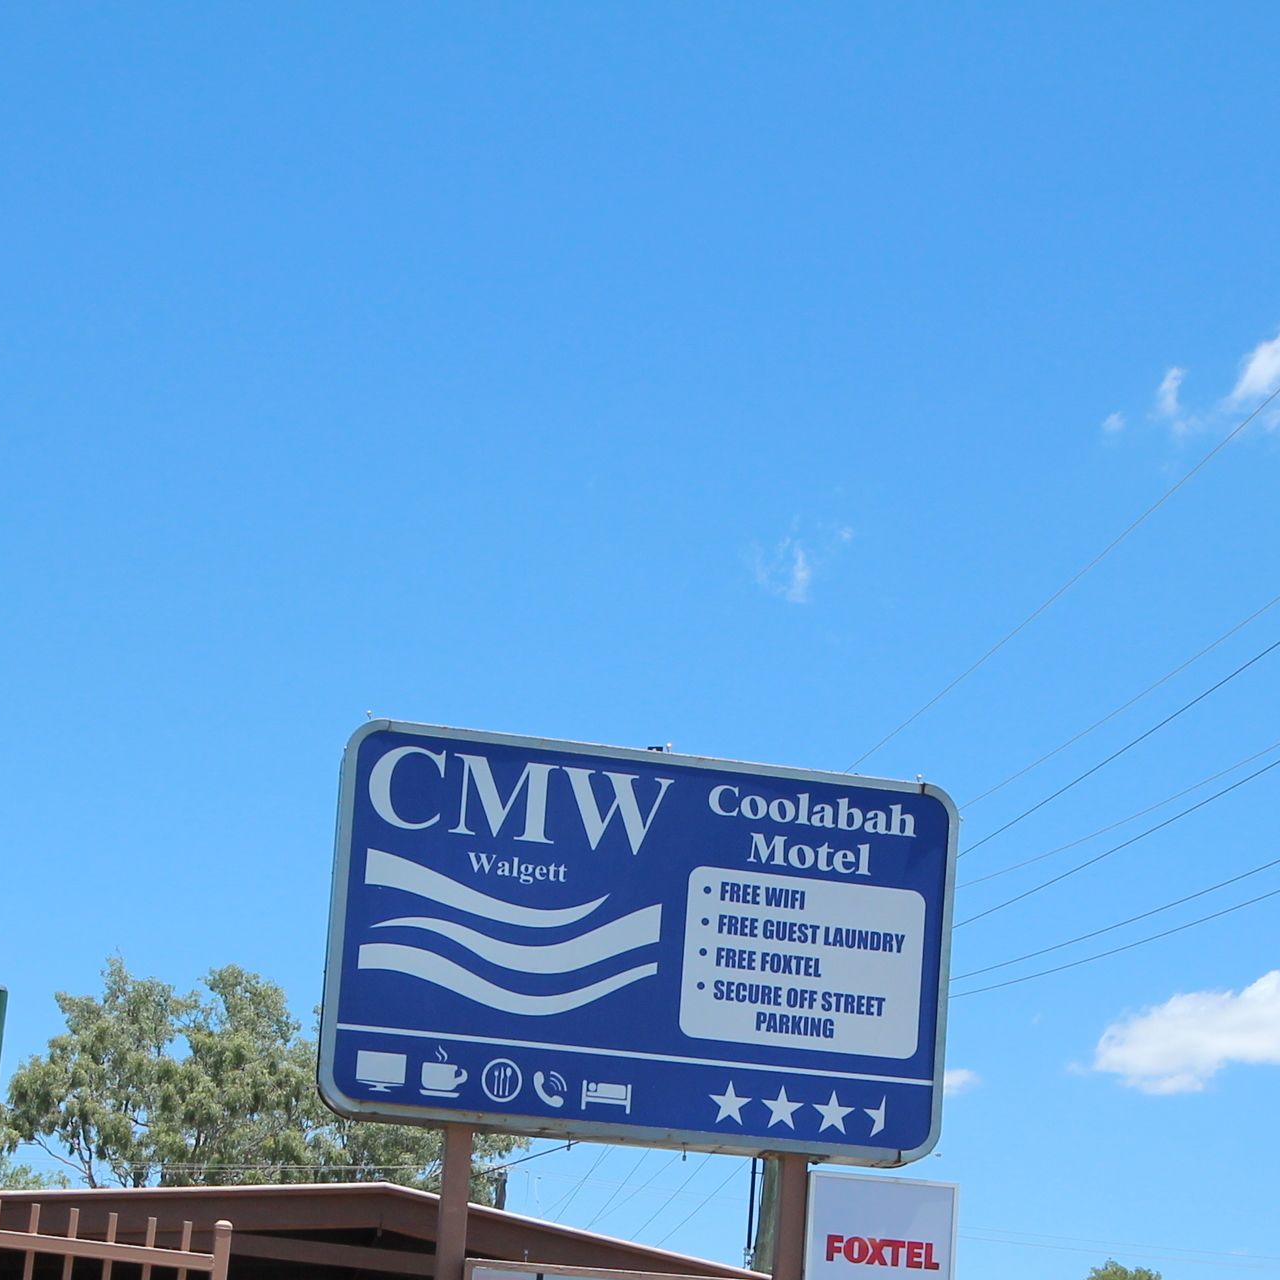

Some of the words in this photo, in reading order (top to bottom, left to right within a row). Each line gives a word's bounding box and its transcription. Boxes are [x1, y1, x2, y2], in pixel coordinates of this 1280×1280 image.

[368, 745, 674, 856] CMW
[708, 785, 916, 837] Coolabah
[467, 851, 568, 884] Walgett
[748, 833, 871, 876] Motel
[720, 882, 760, 905] FREE
[765, 887, 806, 910] WIFI
[718, 914, 758, 937] FREE
[763, 920, 820, 944] GUEST
[824, 927, 906, 954] LAUNDRY
[715, 947, 756, 971] FREE
[761, 952, 821, 978] FOXTEL
[713, 980, 782, 1006] SECURE
[786, 988, 817, 1009] OFF
[821, 993, 886, 1016] STREET
[755, 1012, 835, 1039] PARKING
[826, 1234, 940, 1271] FOXTEL
